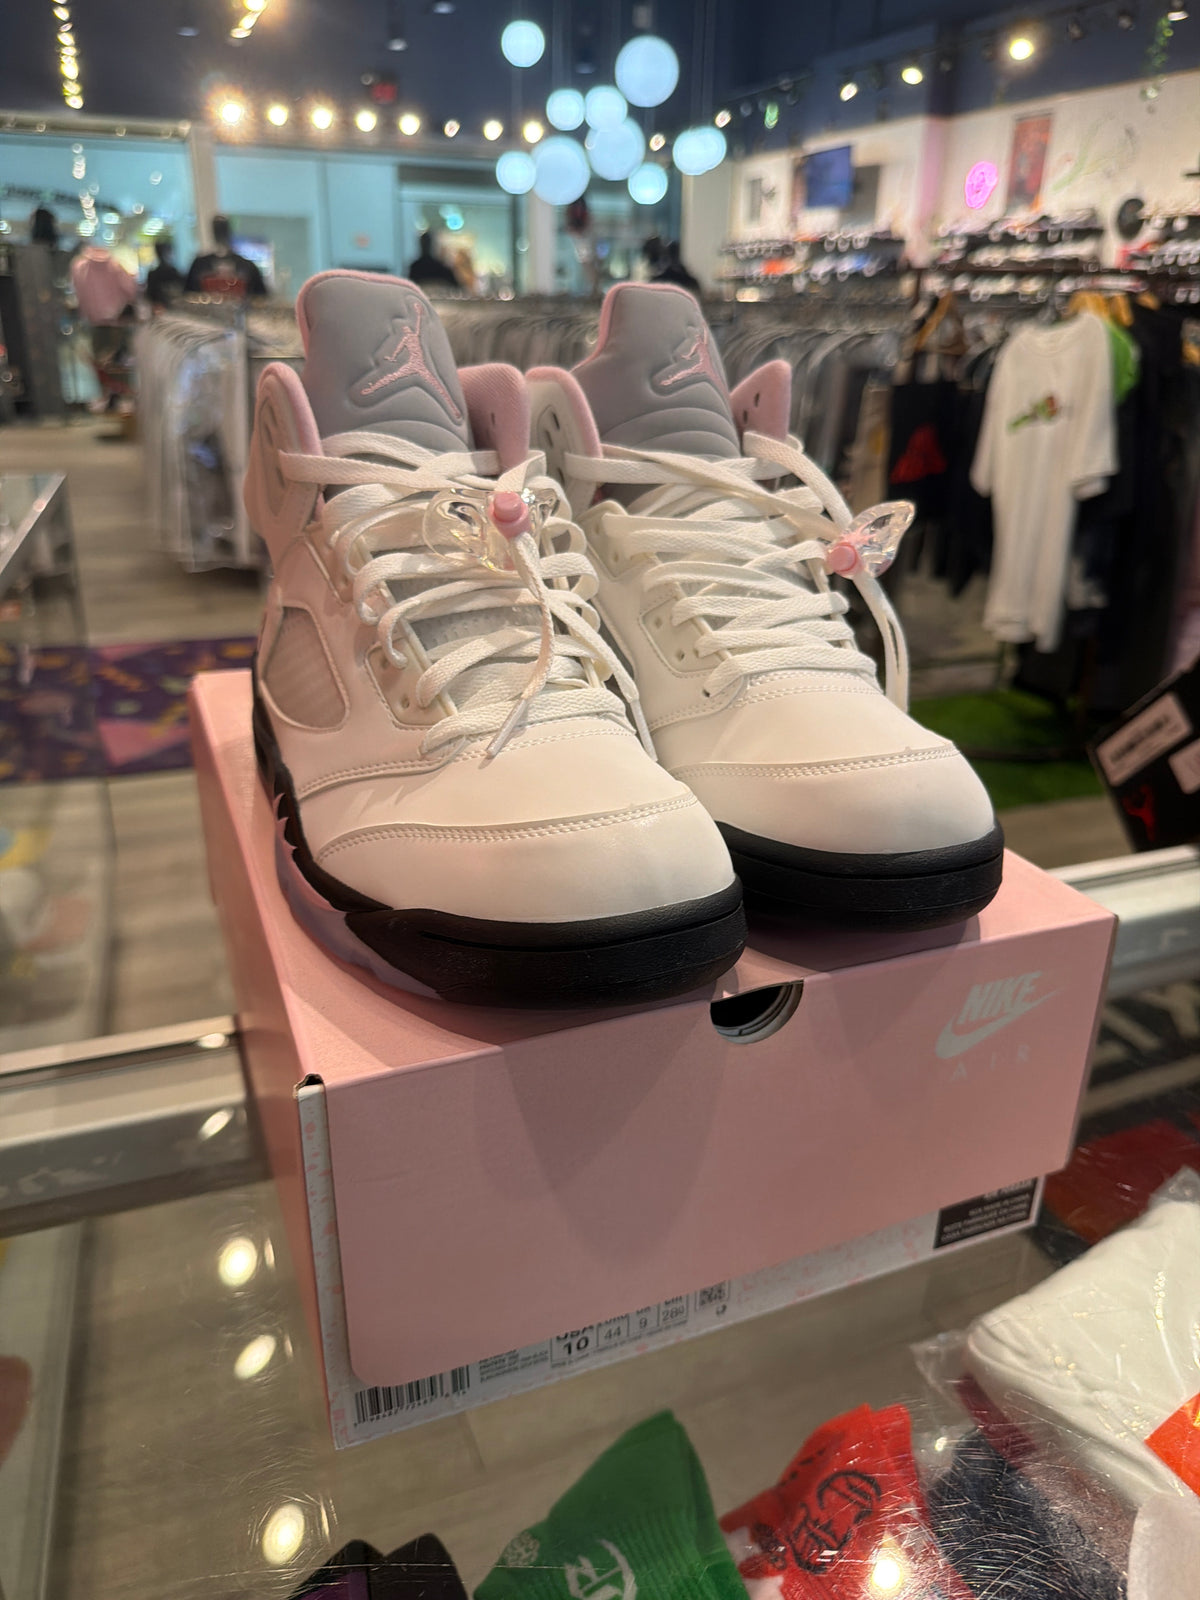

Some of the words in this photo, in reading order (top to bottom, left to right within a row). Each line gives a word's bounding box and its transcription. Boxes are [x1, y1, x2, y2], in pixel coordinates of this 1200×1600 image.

[956, 970, 1042, 1025] NIKE
[951, 1044, 1031, 1080] AIR
[563, 1336, 589, 1355] 10
[604, 1327, 621, 1339] 44
